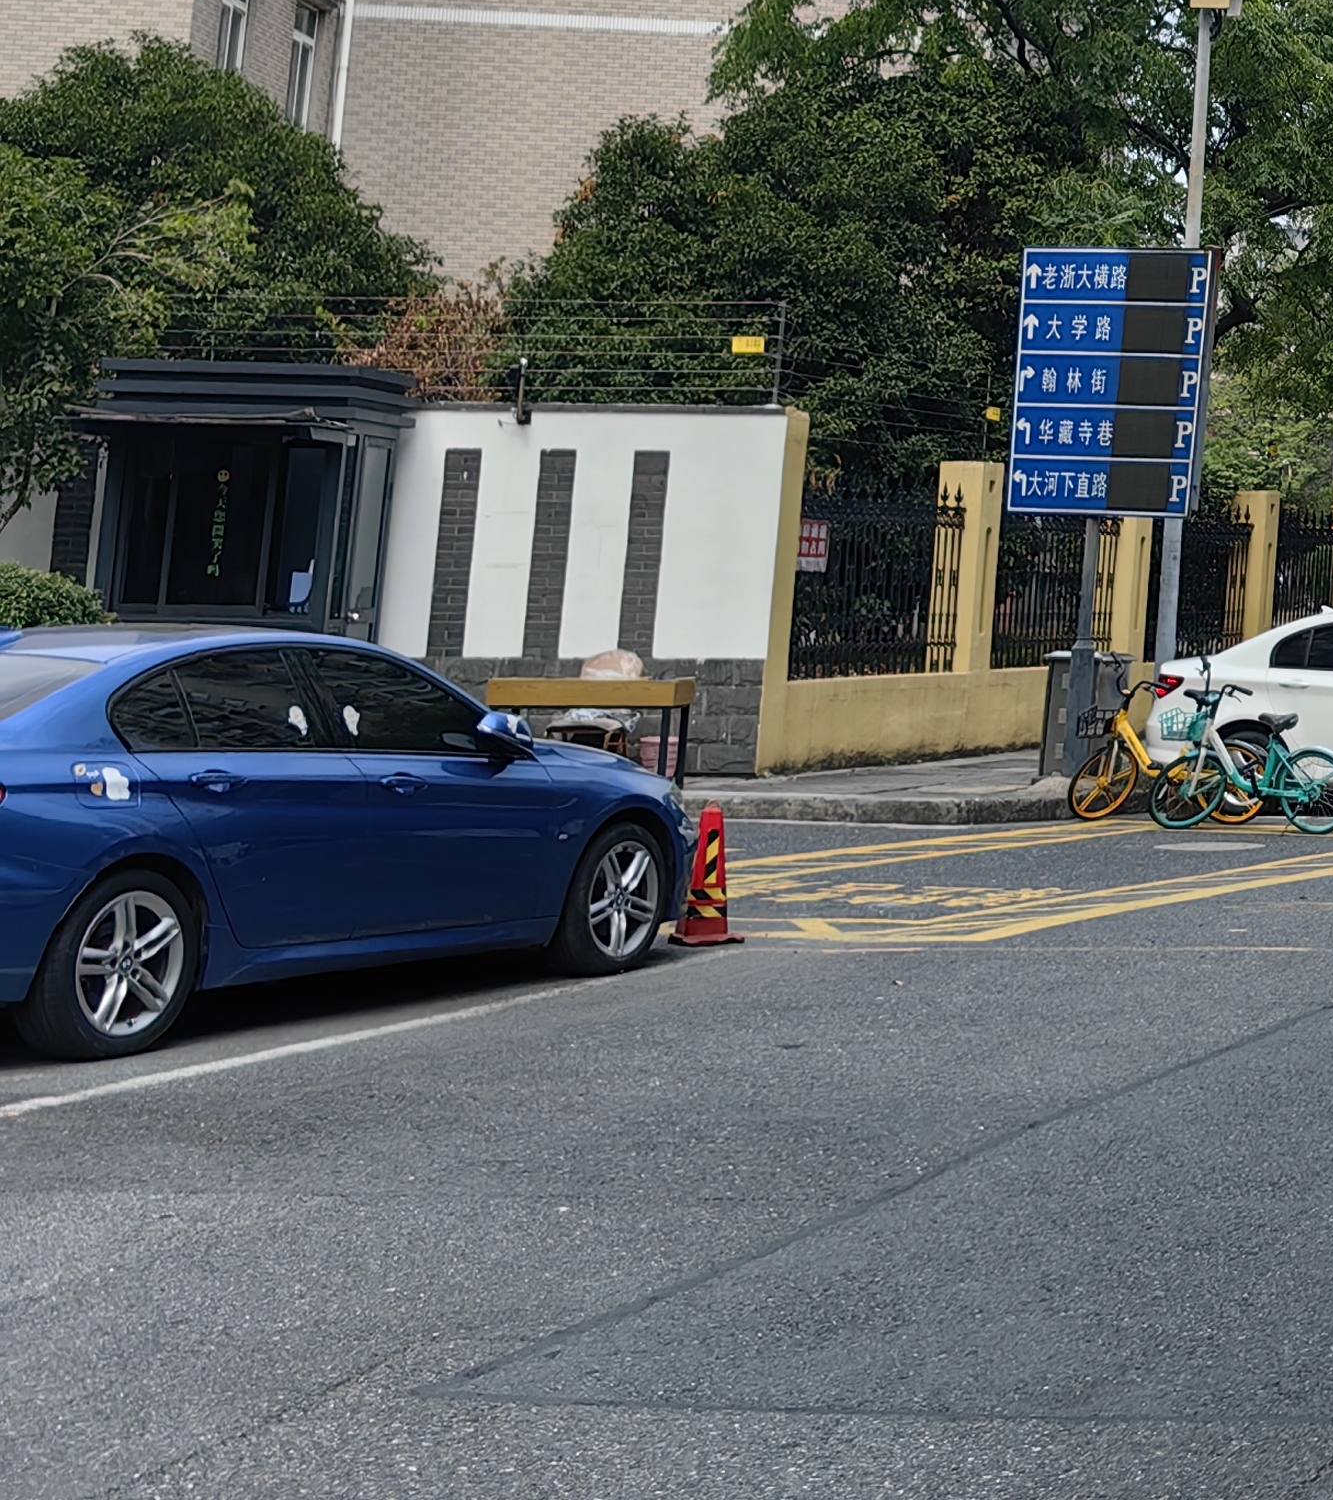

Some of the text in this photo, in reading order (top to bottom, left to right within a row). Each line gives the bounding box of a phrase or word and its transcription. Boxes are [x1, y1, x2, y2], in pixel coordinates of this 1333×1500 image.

[1042, 263, 1206, 293] 老浙大横路 P
[1045, 314, 1202, 344] 大学路 P
[1041, 367, 1197, 397] 翰林街 P
[1038, 419, 1192, 448] 华藏寺巷 P
[1027, 470, 1187, 502] 大河下直路 P
